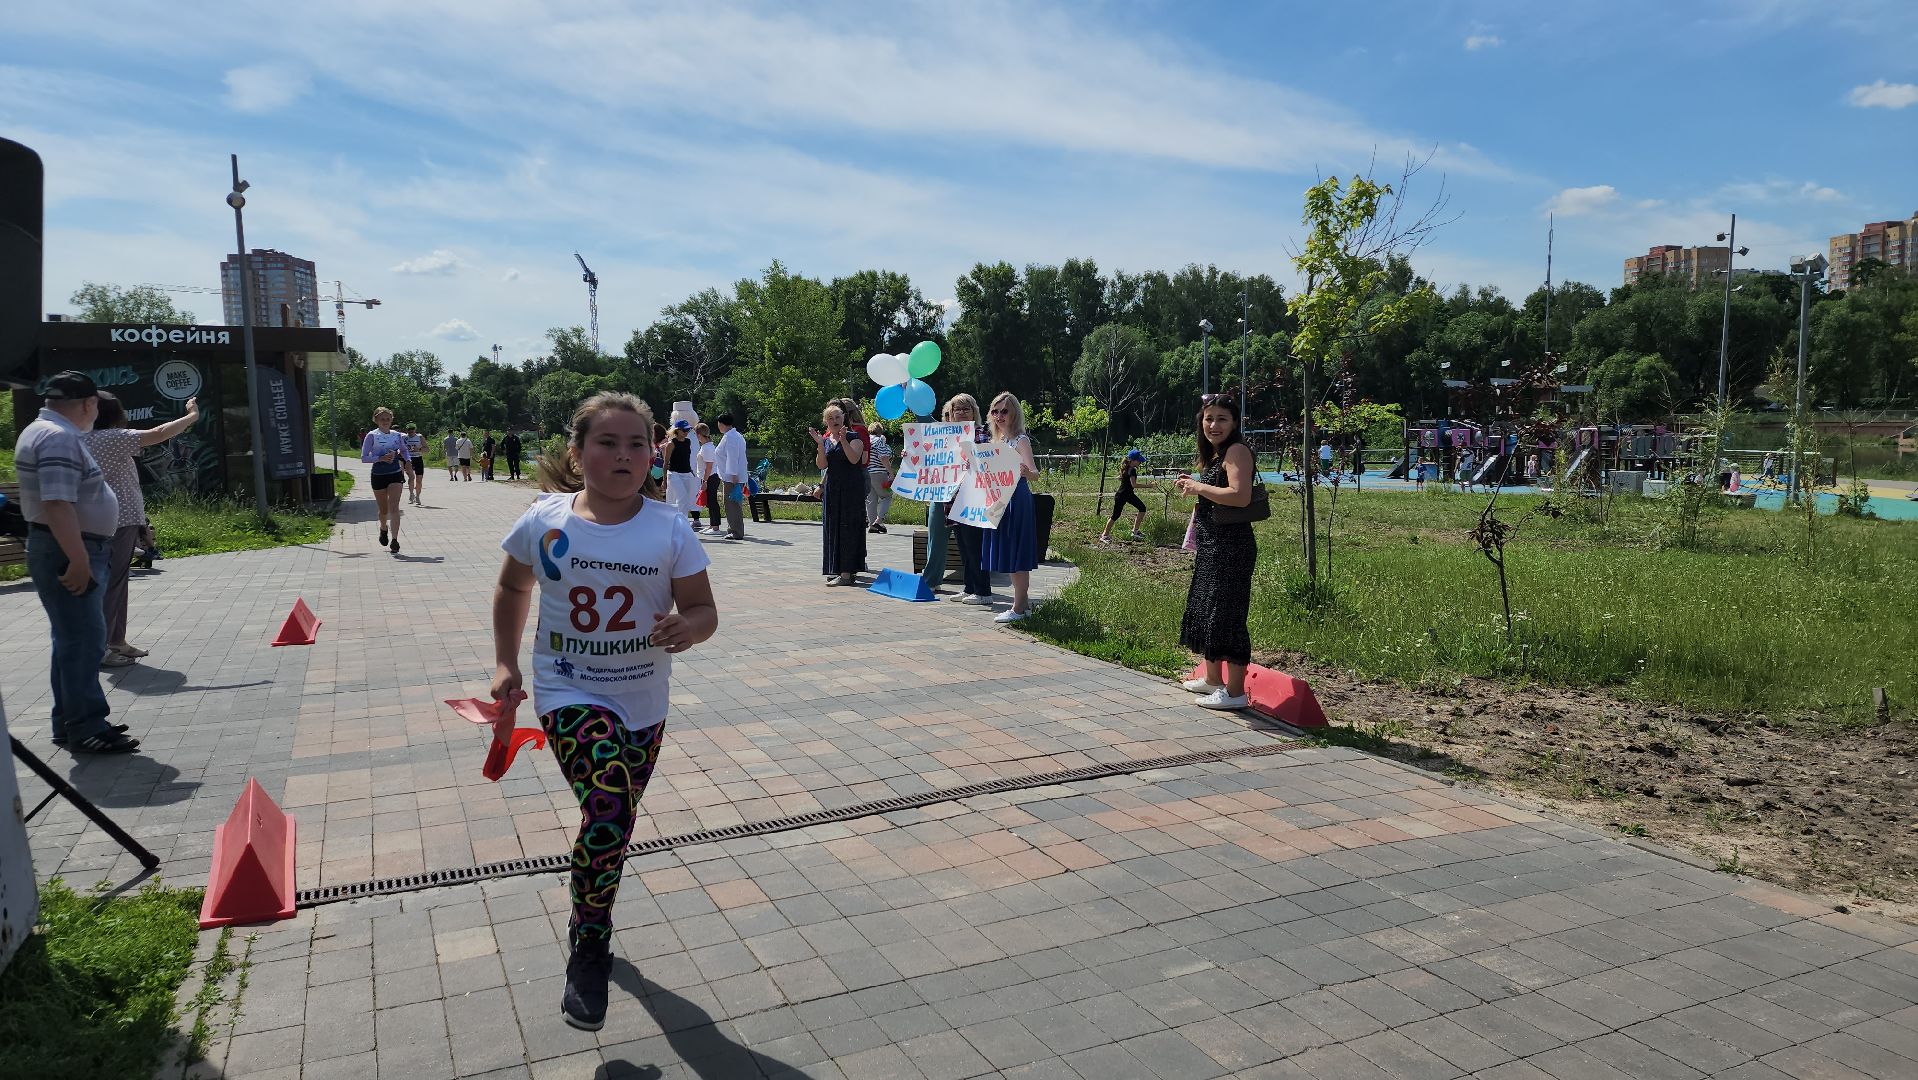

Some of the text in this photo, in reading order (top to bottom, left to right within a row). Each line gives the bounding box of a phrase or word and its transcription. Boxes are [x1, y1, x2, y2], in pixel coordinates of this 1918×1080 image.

[110, 324, 230, 348] кофейня
[166, 370, 188, 380] MAKE
[166, 377, 193, 389] COFFEE
[571, 557, 659, 576] Ростелеком
[569, 585, 636, 633] 82
